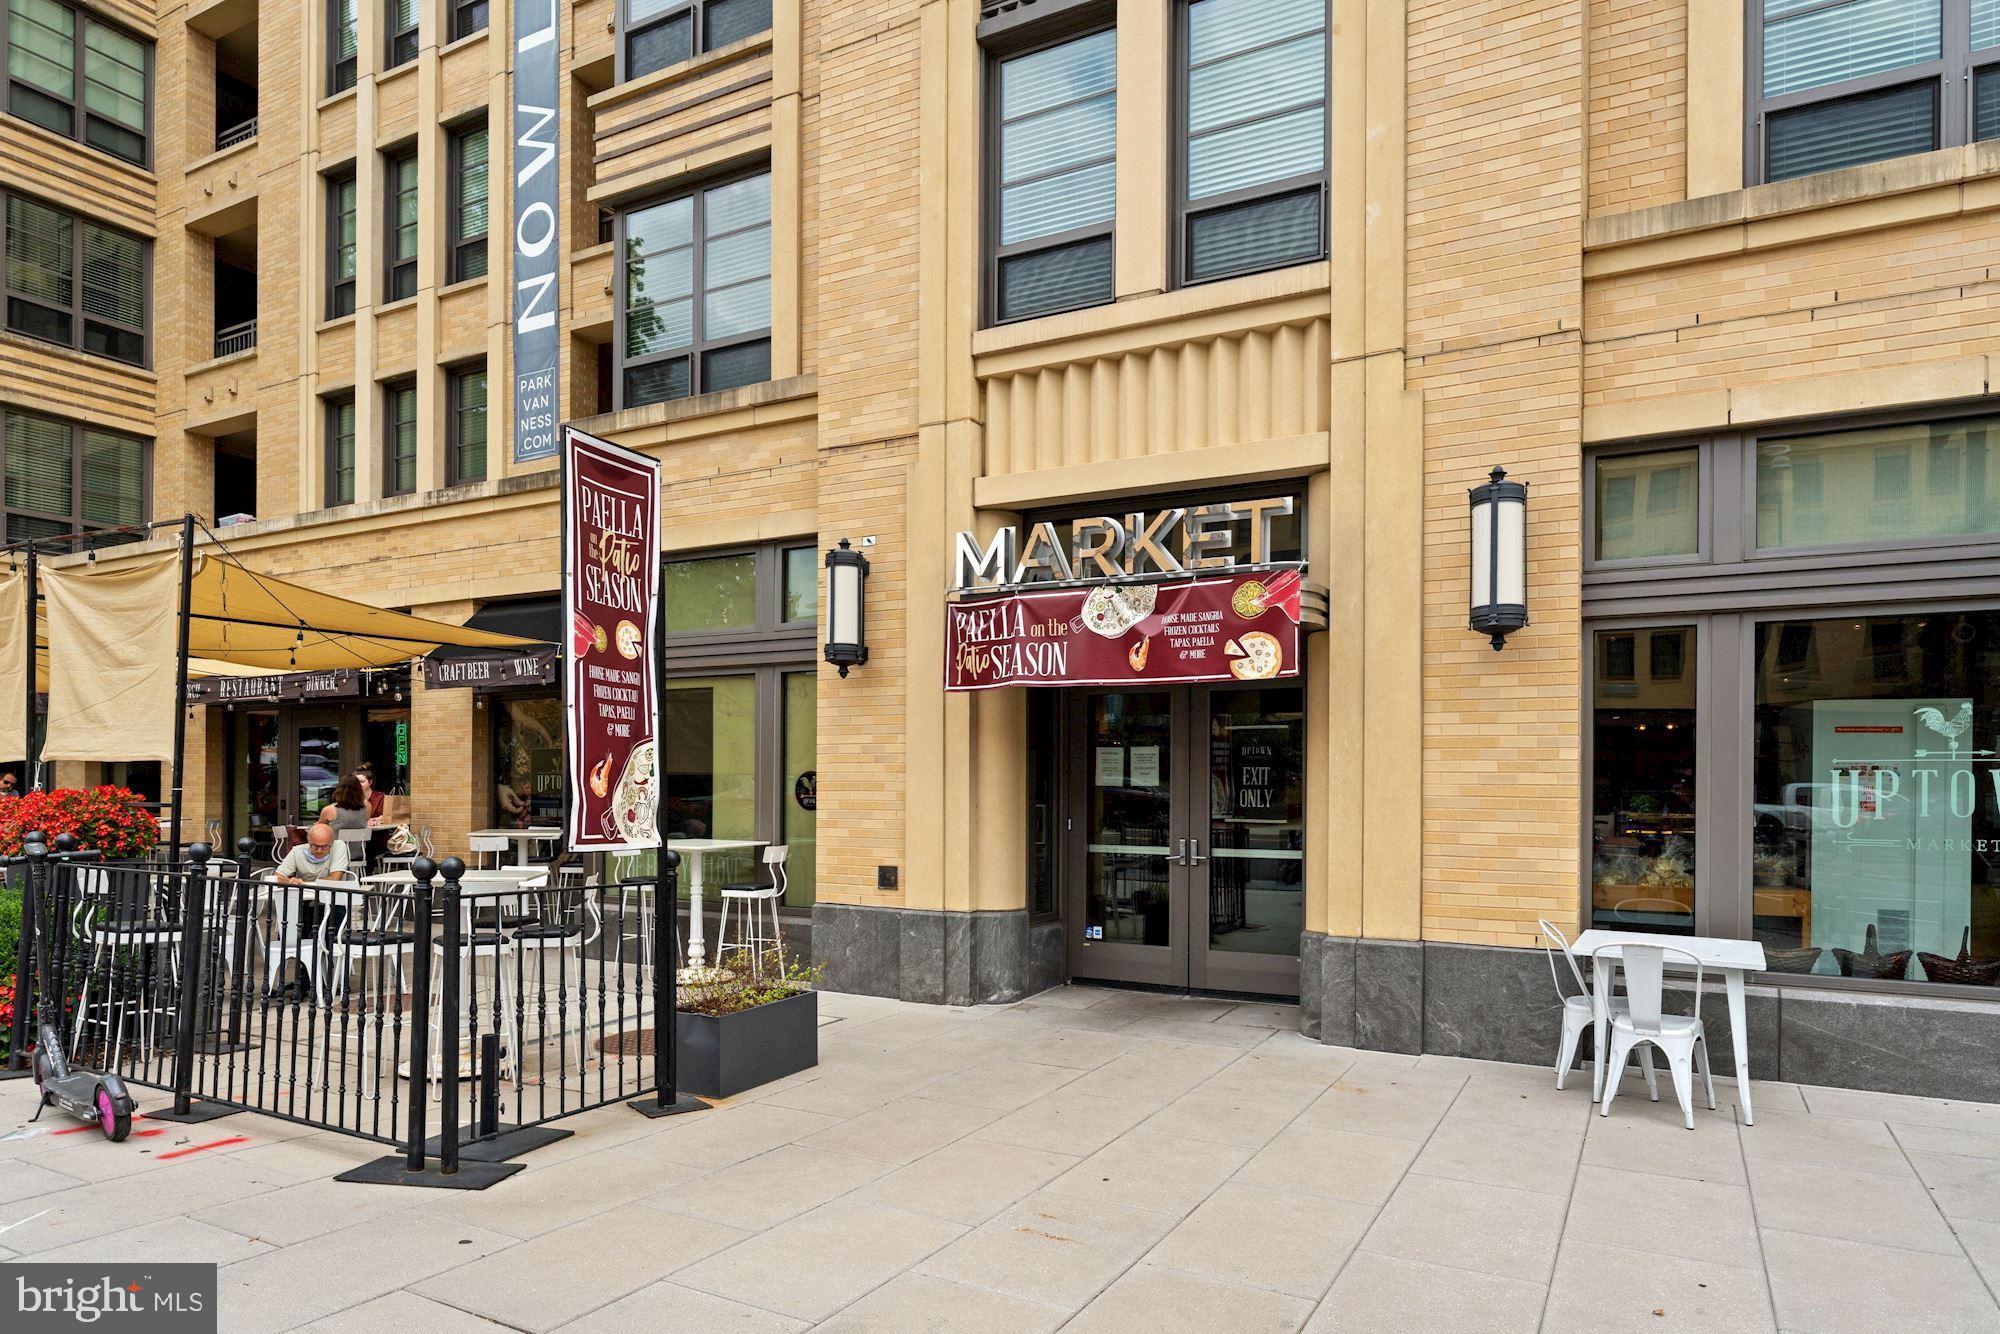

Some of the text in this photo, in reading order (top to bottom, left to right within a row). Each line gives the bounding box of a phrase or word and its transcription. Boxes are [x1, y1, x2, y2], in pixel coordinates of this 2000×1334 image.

[516, 104, 556, 334] NOW
[520, 374, 552, 393] PARK
[523, 395, 549, 412] VAN
[521, 413, 552, 432] NESS
[521, 433, 552, 451] .COM
[581, 485, 644, 540] PAELLA
[589, 532, 598, 545] on
[955, 495, 1294, 588] MARKET
[588, 529, 640, 583] the Patio
[586, 564, 642, 614] SEASON
[956, 604, 1068, 644] PAELLA on the
[1161, 610, 1223, 624] HOUSE MADE SANGRIA
[1164, 623, 1220, 636] FROZEN COCKTAILS
[1192, 636, 1215, 647] PAELLA
[956, 641, 1068, 685] Patio SEASON
[1189, 649, 1206, 659] MORE
[514, 657, 539, 676] WINE
[605, 668, 621, 684] MADE
[220, 676, 284, 698] RESTAURANT
[593, 684, 611, 700] FROZEN
[615, 723, 630, 737] MORE
[397, 725, 407, 764] OPEN
[1241, 745, 1272, 756] UPTOWN
[537, 774, 562, 793] UPTO
[1242, 766, 1271, 786] EXIT
[1240, 788, 1274, 808] ONLY
